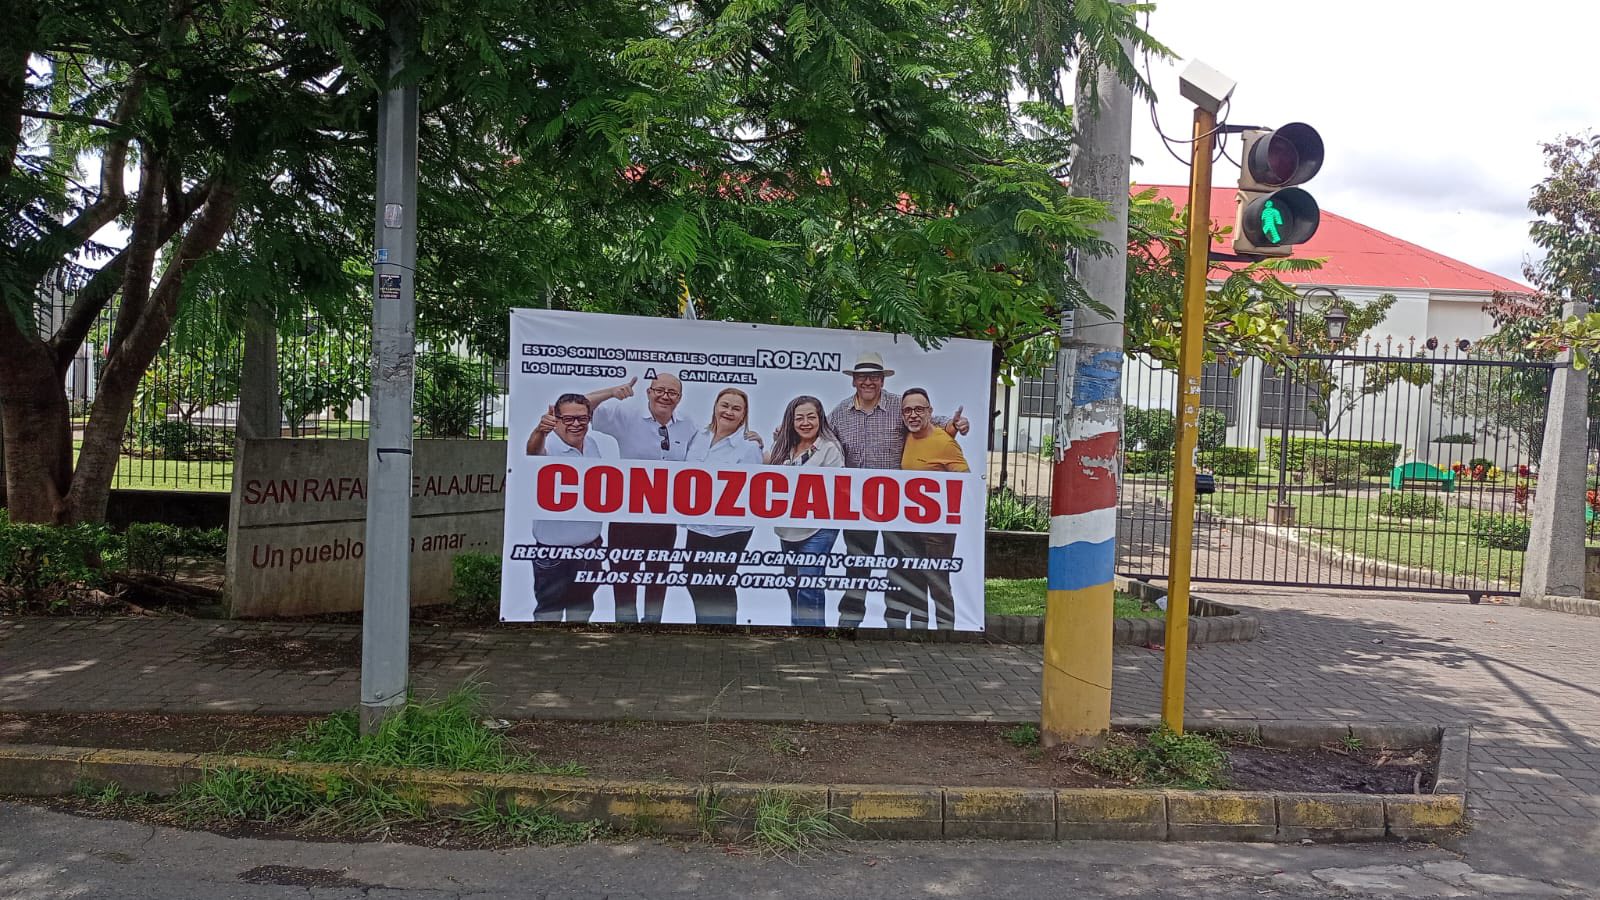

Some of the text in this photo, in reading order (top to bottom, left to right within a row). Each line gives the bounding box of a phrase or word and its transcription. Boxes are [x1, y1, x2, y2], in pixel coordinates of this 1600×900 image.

[522, 344, 841, 371] ESTOS SON LOS MISERABLES QUE LE ROBAN
[522, 361, 757, 384] LOS IMPUESTOS A SAN RAFAEL
[244, 478, 298, 504] SAN
[303, 477, 368, 503] RAFA
[537, 464, 963, 524] CONOZCALOS!
[252, 543, 284, 569] Un
[290, 538, 364, 571] pueblo
[512, 546, 962, 571] RECURSOS QUE ERAN PARA LA CAÑADA Y CERRO TIANES
[574, 570, 901, 591] ELLOS SE LOS DAN A OTROS DISTRITOS...
